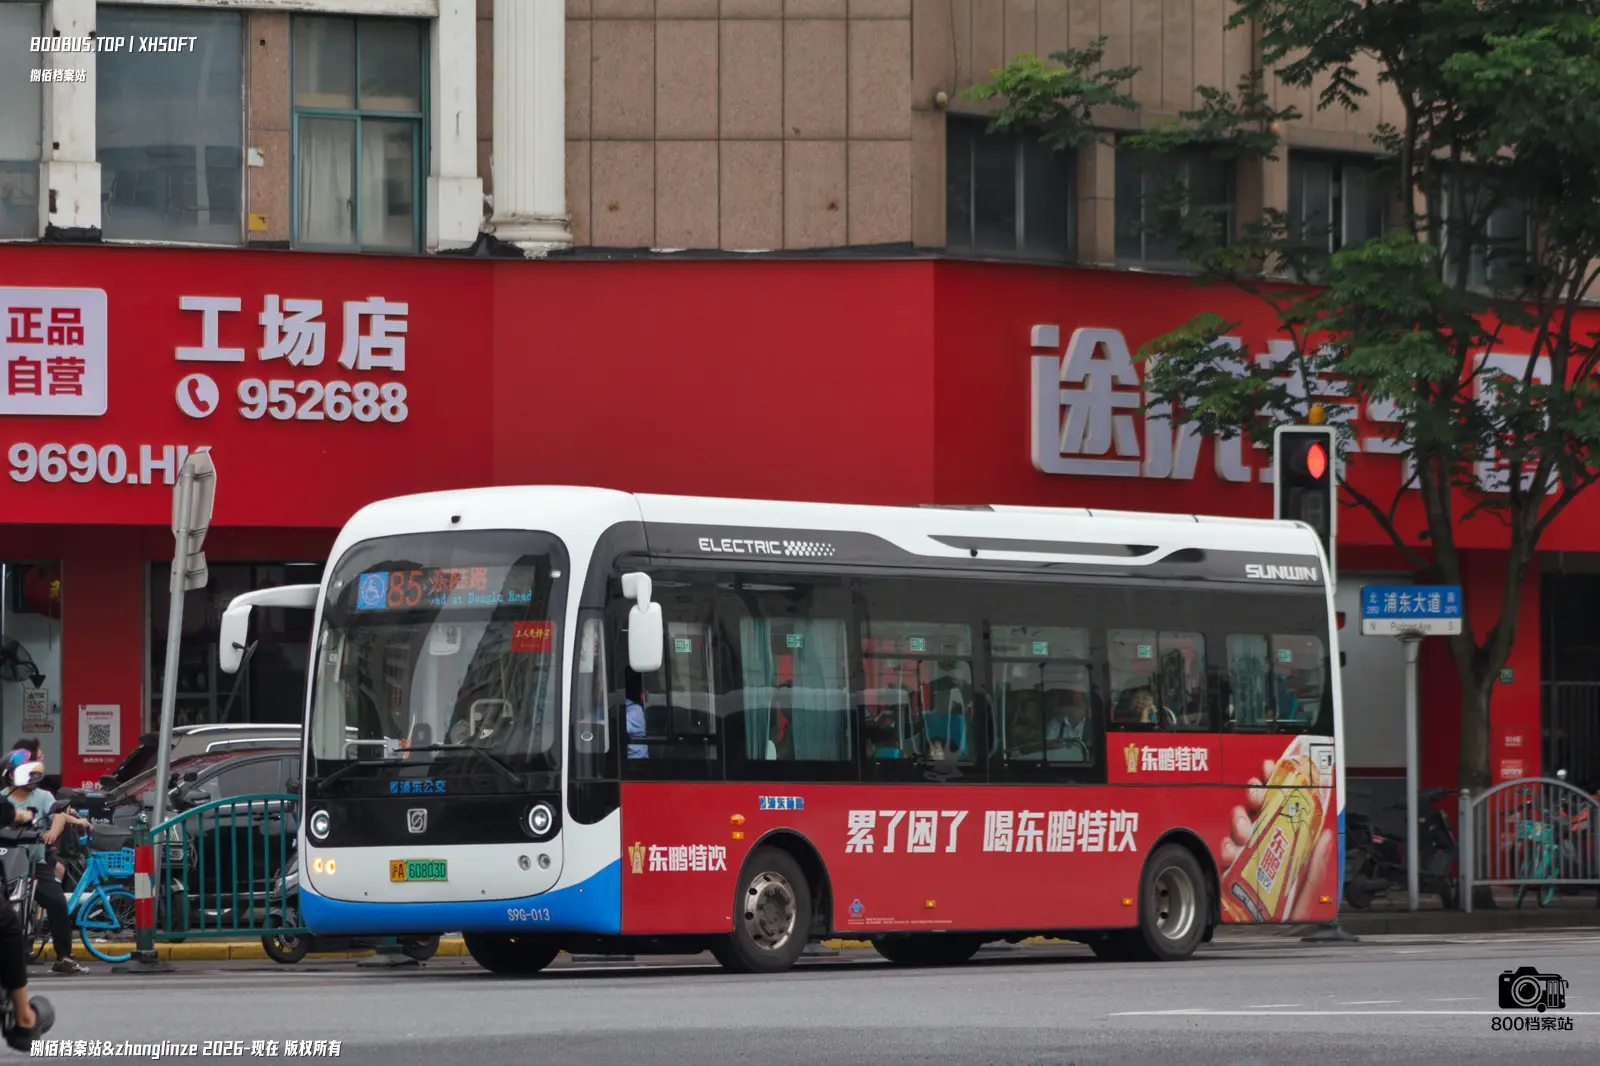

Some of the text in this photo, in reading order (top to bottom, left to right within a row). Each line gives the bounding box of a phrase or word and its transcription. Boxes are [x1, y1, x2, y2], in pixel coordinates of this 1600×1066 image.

[6, 306, 85, 346] 正品
[174, 294, 409, 371] 工场店
[7, 355, 85, 396] 自营
[237, 379, 409, 423] 952688
[698, 537, 782, 555] ELECTRIC
[1245, 564, 1318, 581] SUNWIN
[386, 571, 425, 607] 85
[508, 589, 533, 602] Road
[1383, 591, 1441, 613] 浦东大道
[1370, 623, 1376, 631] N
[1141, 746, 1208, 771] 东鹏特饮
[400, 780, 446, 793] 浦东公交
[845, 809, 1139, 853] 累了困了 喝东鹏特饮
[649, 844, 727, 872] 东鹏特饮
[507, 908, 550, 921] S9G-013
